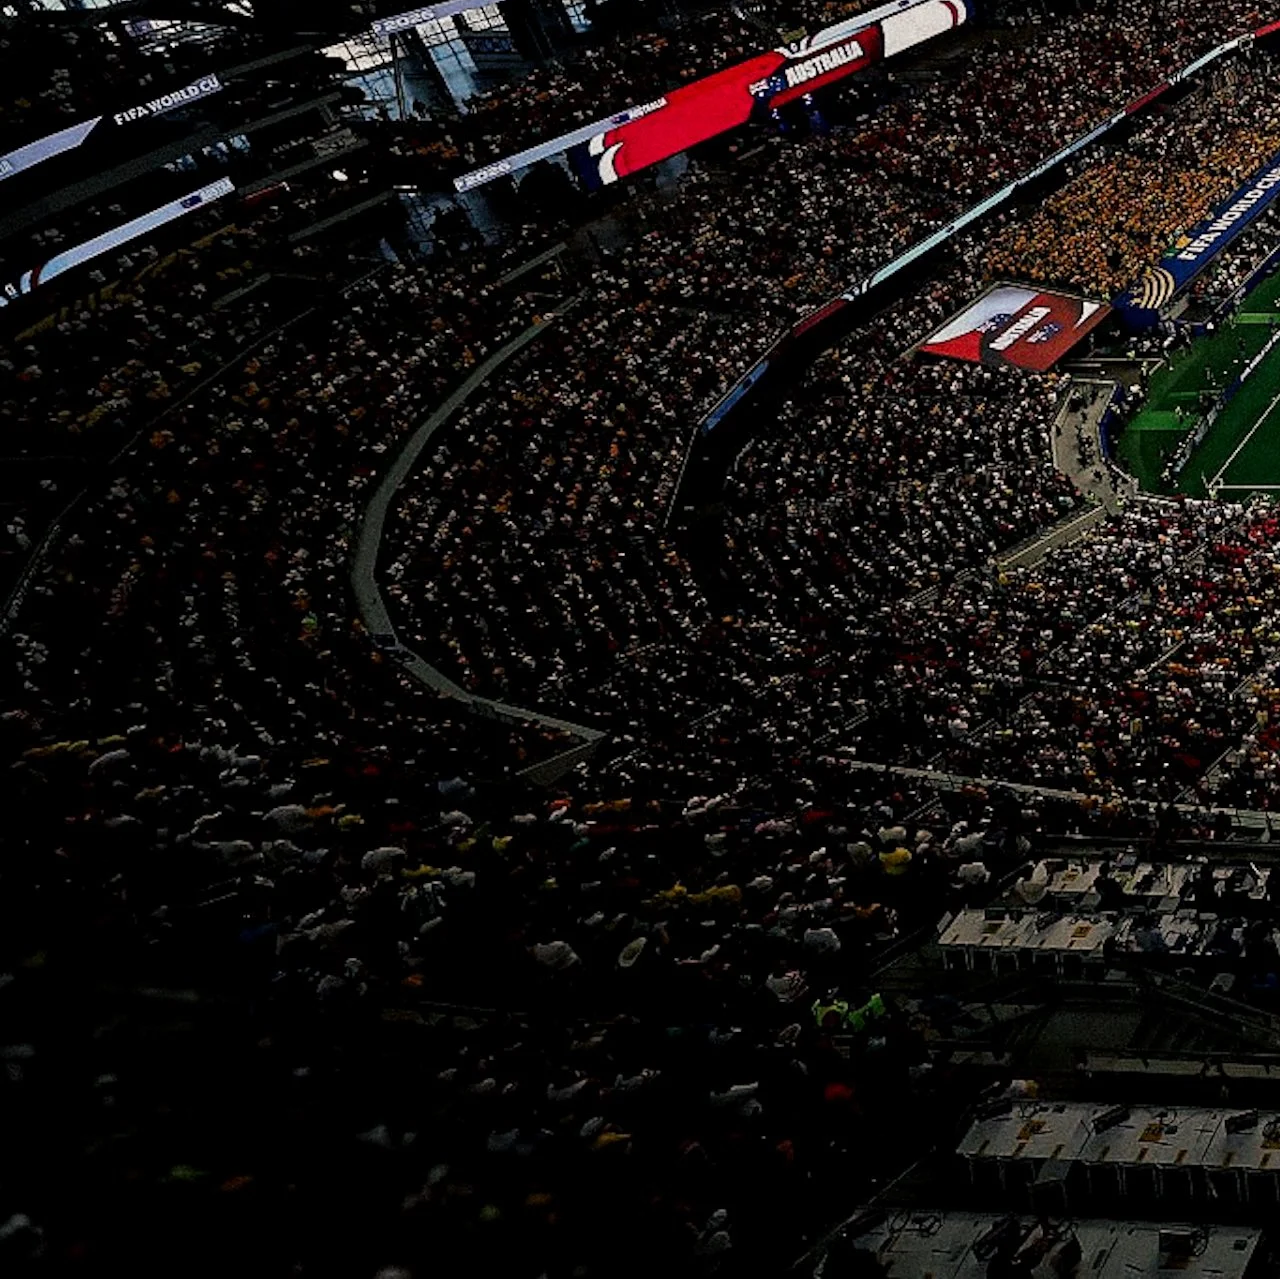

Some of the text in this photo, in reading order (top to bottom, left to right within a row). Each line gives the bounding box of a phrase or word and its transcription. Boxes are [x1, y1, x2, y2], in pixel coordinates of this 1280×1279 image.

[784, 40, 865, 89] AUSTRALIA
[113, 105, 149, 126] FIFA
[145, 85, 200, 112] WORLD
[1177, 231, 1222, 261] FIFA
[1207, 188, 1265, 232] WORLD
